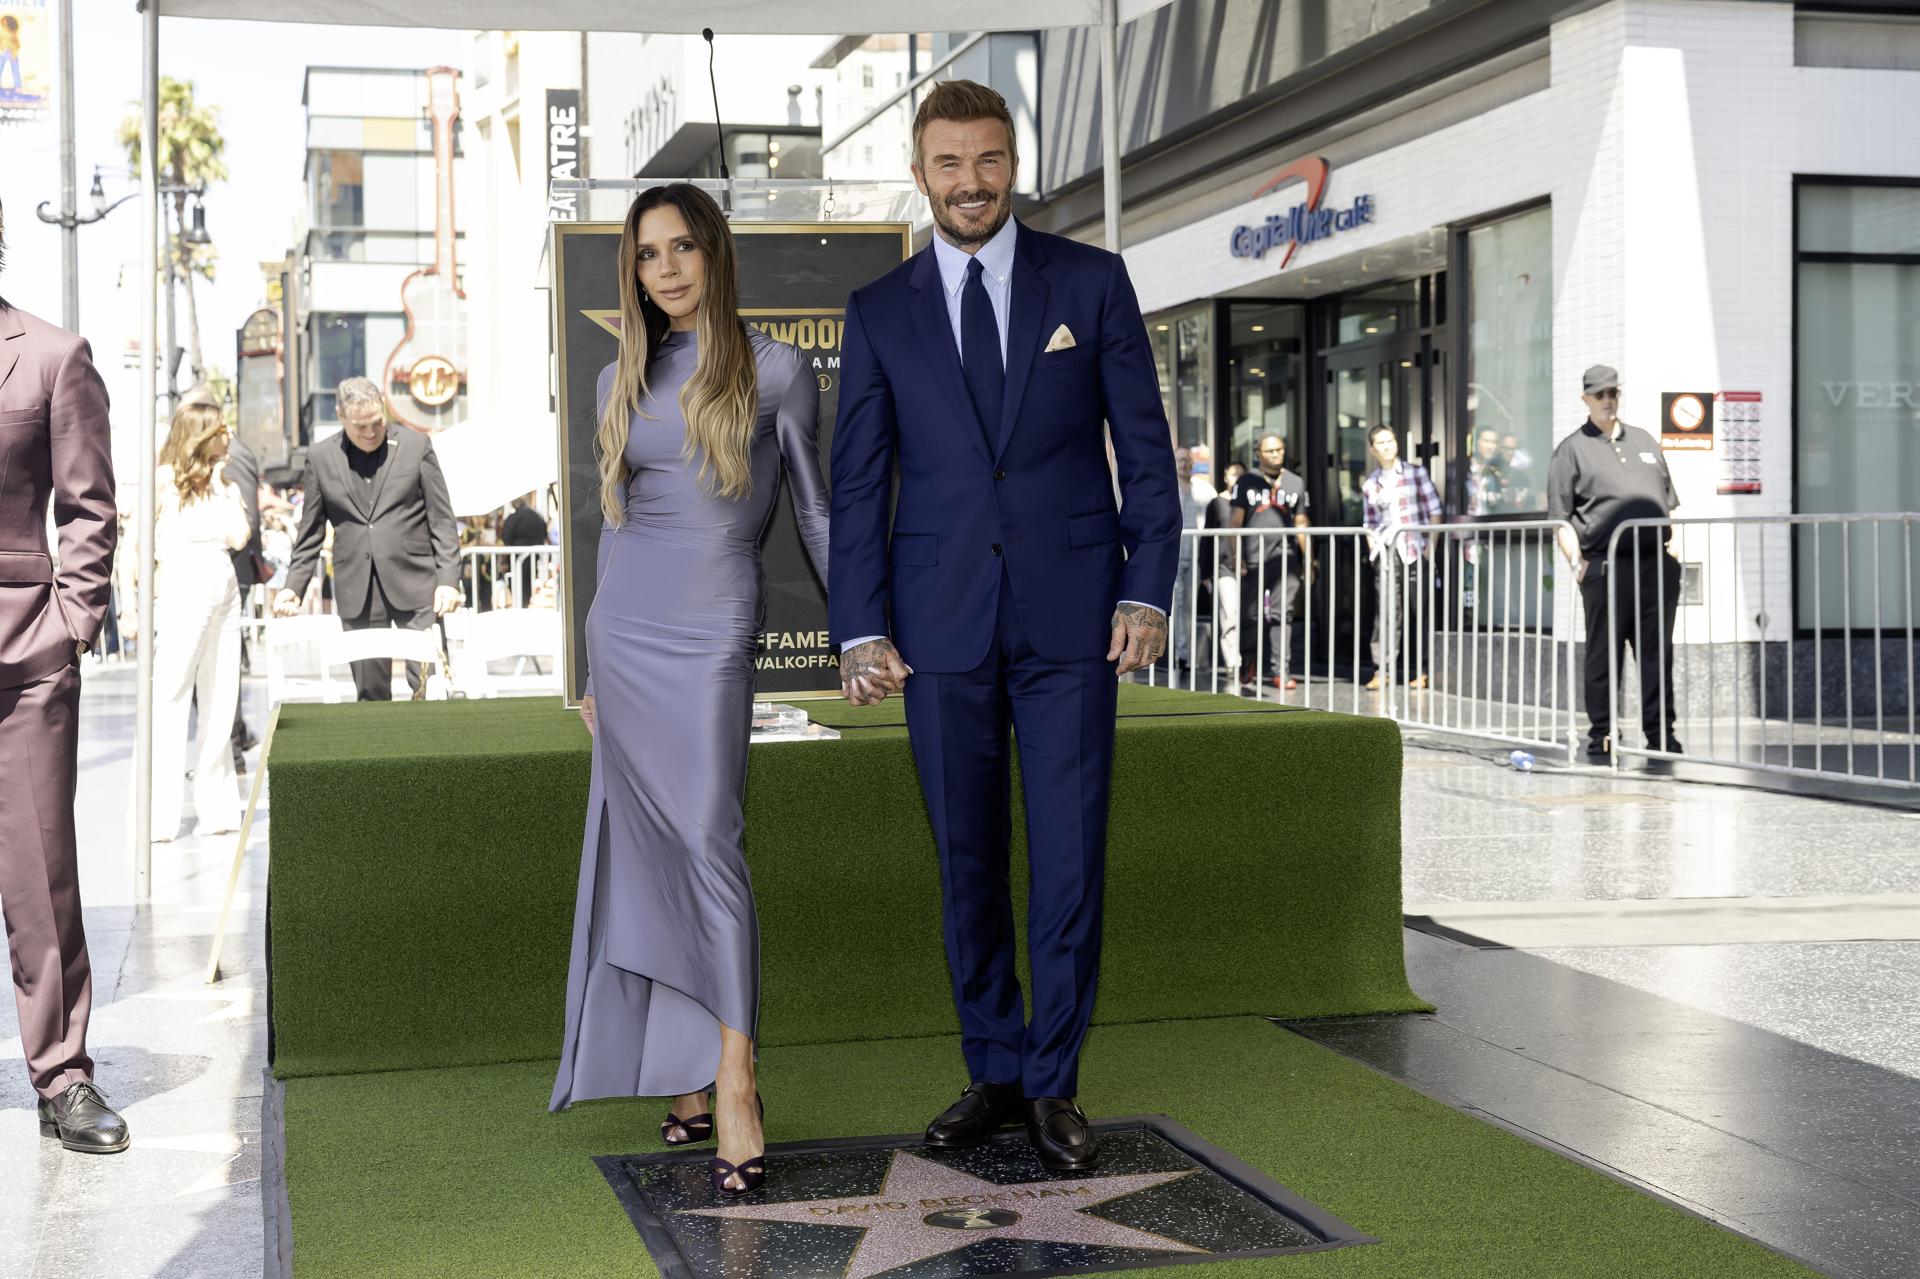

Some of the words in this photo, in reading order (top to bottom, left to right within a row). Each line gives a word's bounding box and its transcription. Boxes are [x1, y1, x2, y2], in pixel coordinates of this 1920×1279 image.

[1819, 380, 1920, 409] VER
[808, 1201, 907, 1217] DAVID
[919, 1186, 1092, 1208] BECKHAM
